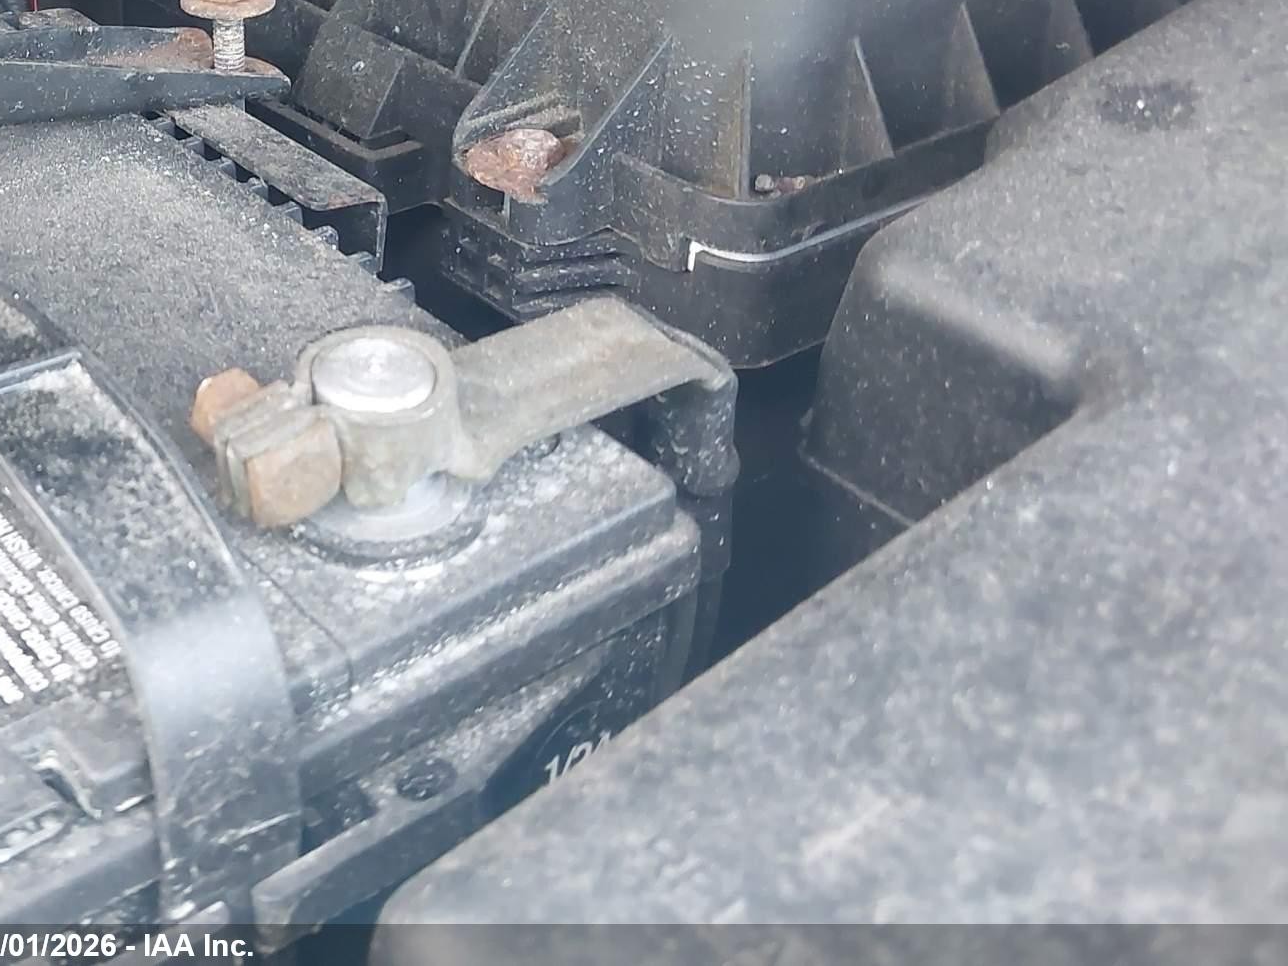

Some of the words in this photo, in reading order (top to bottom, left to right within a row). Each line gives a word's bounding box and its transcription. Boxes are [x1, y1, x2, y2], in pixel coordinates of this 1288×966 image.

[0, 532, 41, 569] WASH
[24, 591, 59, 624] other
[70, 605, 109, 642] cause
[21, 626, 61, 667] cause
[50, 621, 96, 668] contain
[100, 640, 122, 658] to
